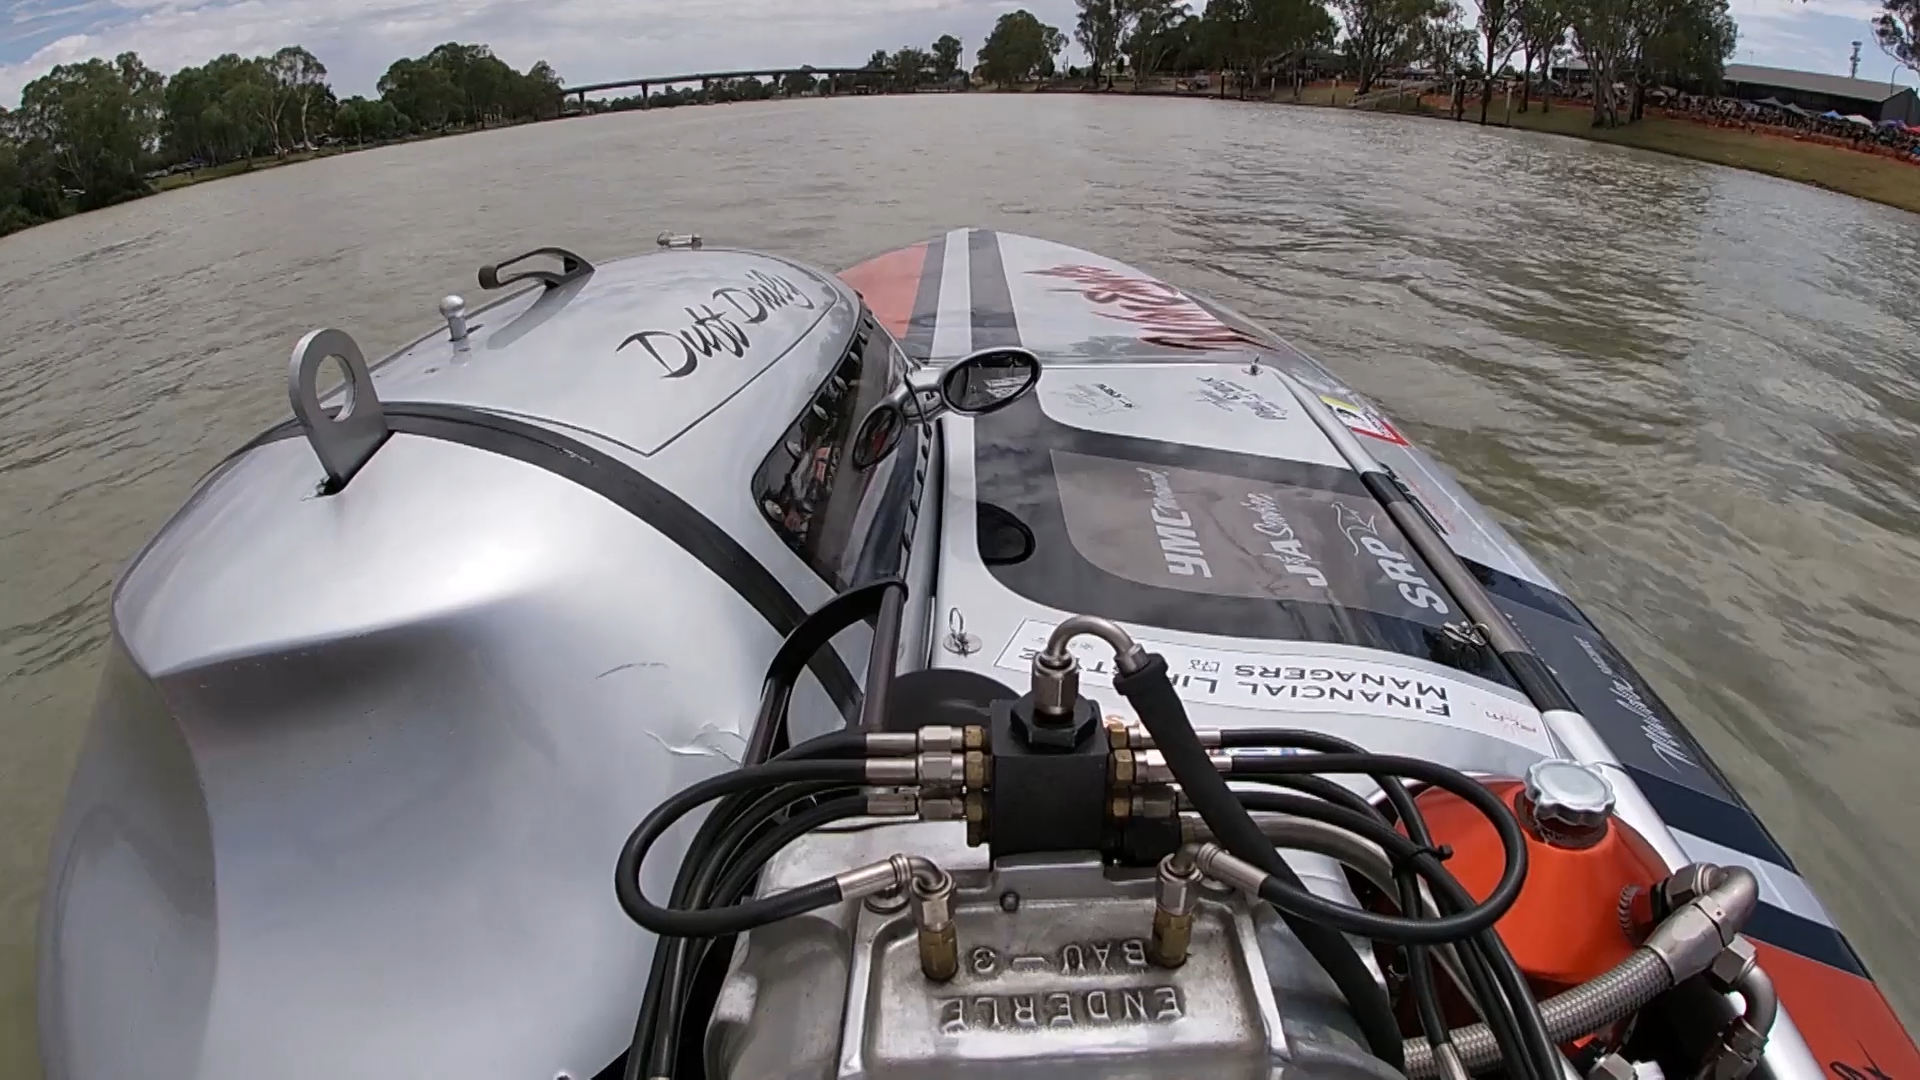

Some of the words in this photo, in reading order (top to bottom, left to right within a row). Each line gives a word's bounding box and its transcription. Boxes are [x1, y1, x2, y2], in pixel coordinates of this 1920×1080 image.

[615, 304, 750, 379] Duff
[1360, 536, 1449, 614] SRP
[1234, 664, 1448, 701] MANAGERS
[1238, 680, 1451, 718] FINANCIAL
[933, 986, 1185, 1035] ENDERLE
